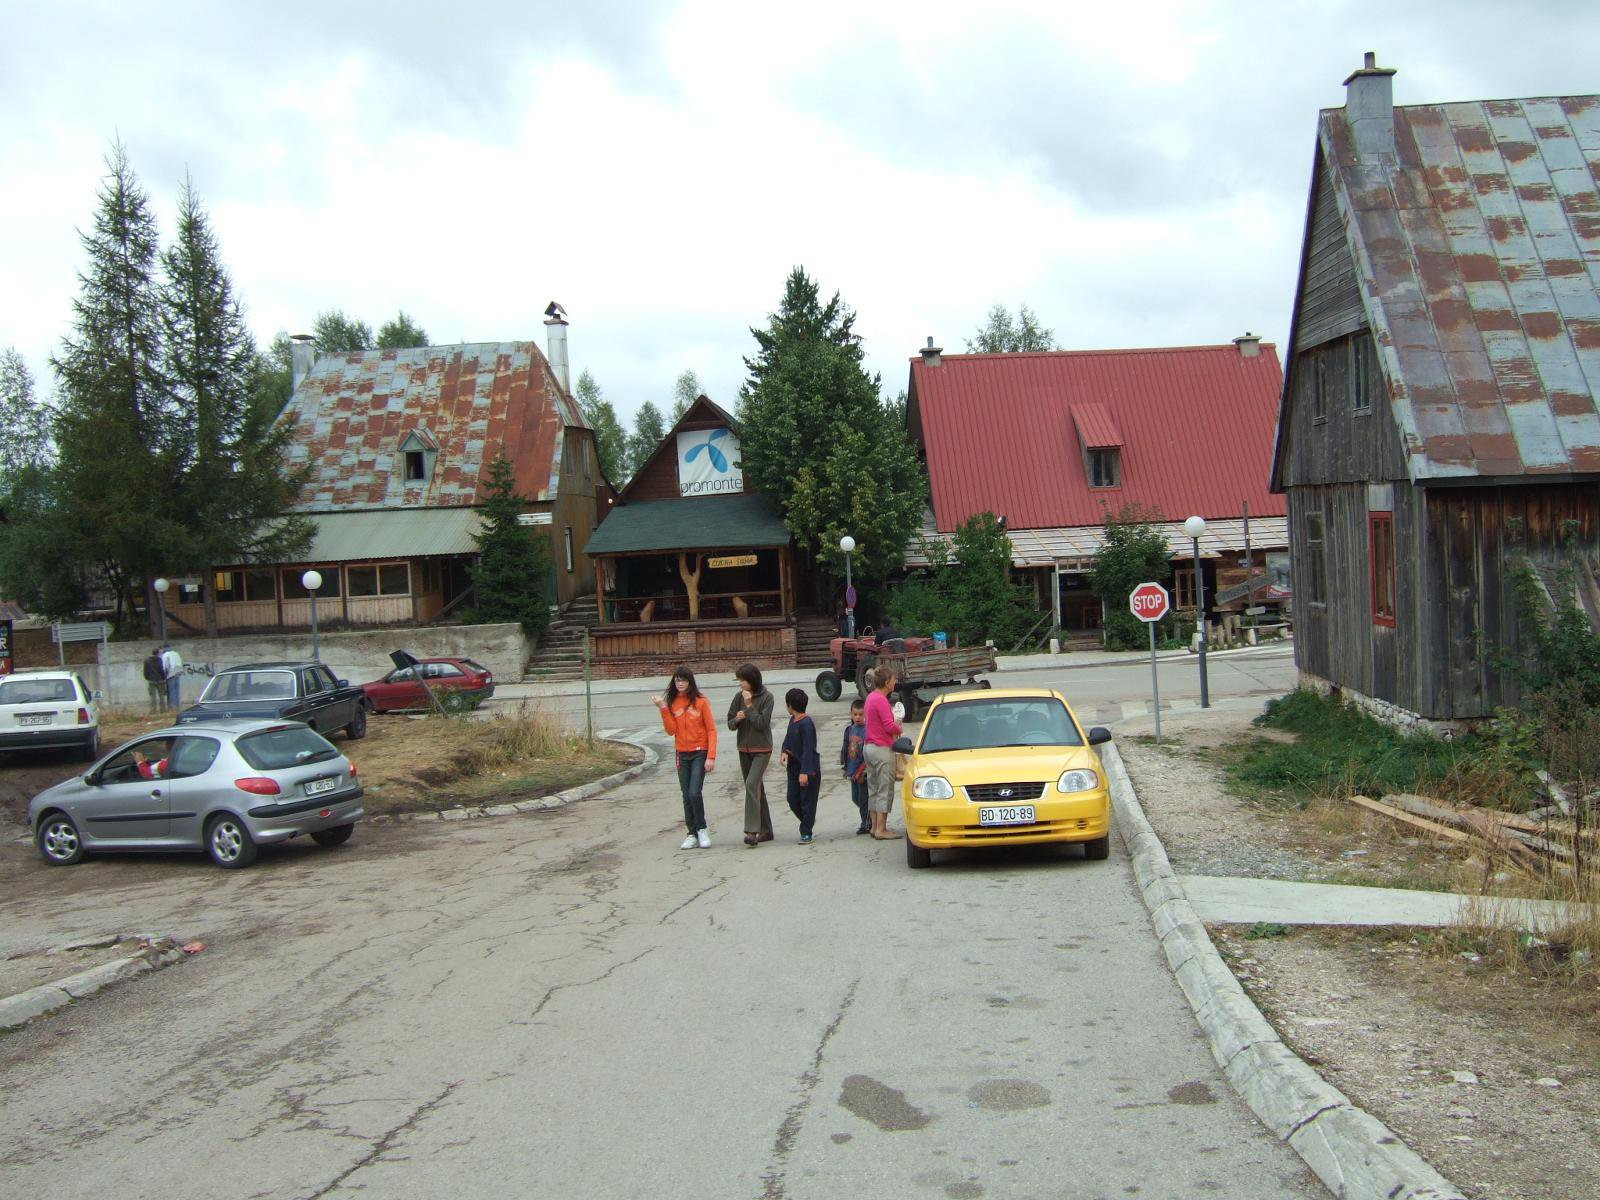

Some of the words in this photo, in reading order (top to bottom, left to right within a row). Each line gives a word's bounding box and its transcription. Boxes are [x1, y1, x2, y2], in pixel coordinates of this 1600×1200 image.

[681, 477, 742, 496] promonte
[1134, 594, 1162, 610] STOP
[981, 809, 995, 821] BD
[999, 807, 1033, 821] 120-89
